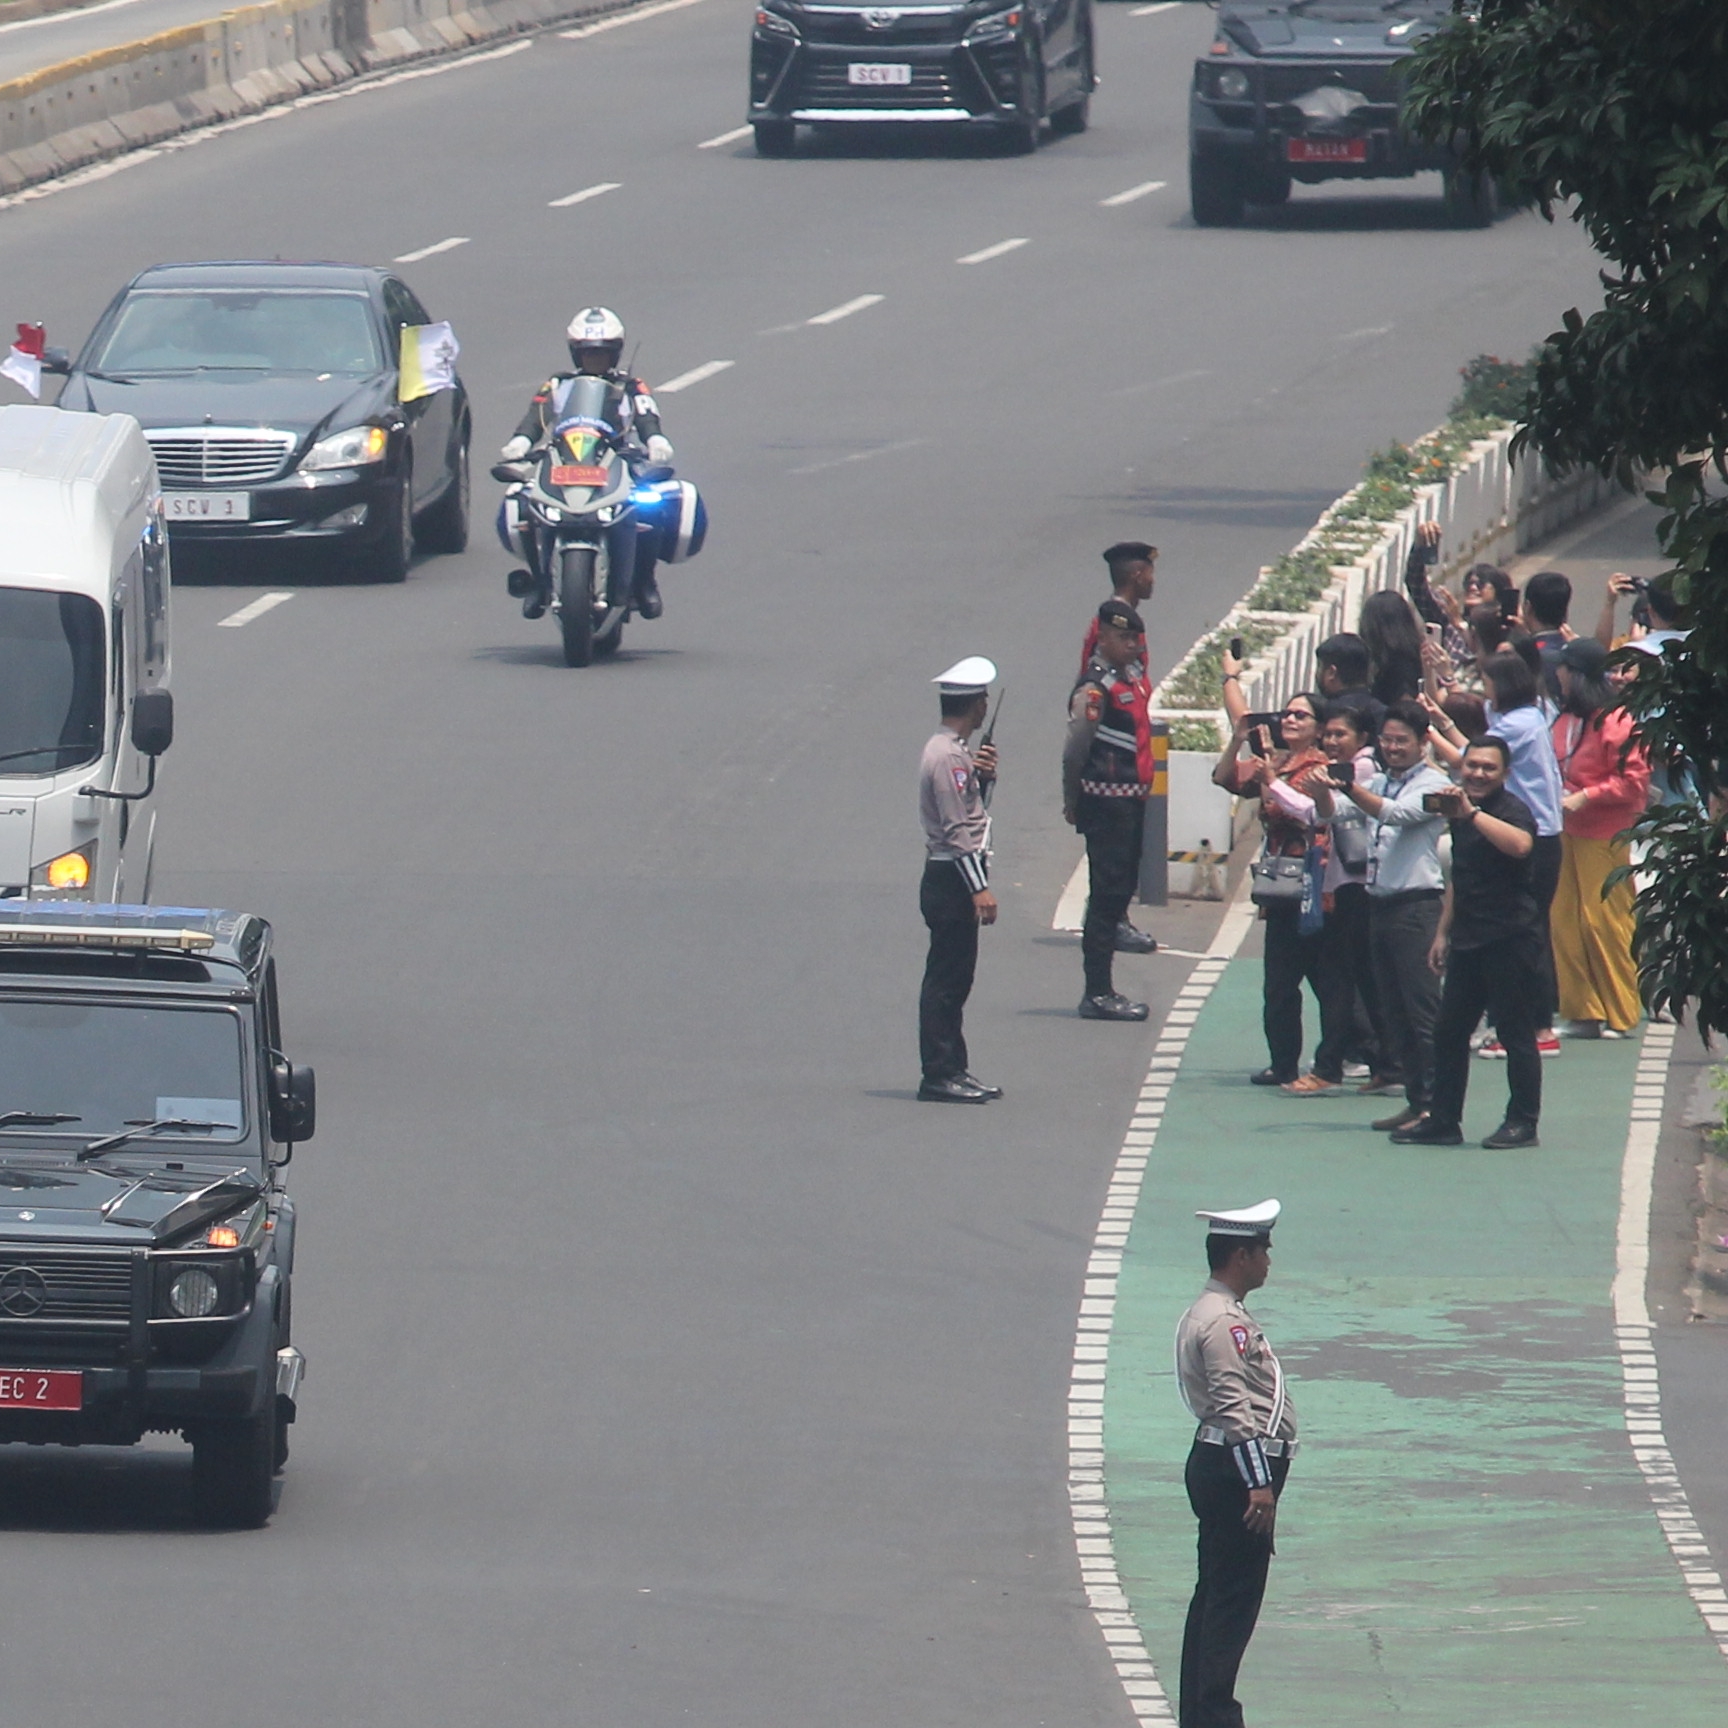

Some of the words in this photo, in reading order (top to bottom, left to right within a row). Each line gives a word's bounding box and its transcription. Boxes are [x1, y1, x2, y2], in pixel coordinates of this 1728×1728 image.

[857, 67, 889, 81] SCV
[898, 68, 903, 81] 1
[173, 499, 210, 515] SCV
[225, 499, 233, 515] 1
[36, 1377, 48, 1400] 2
